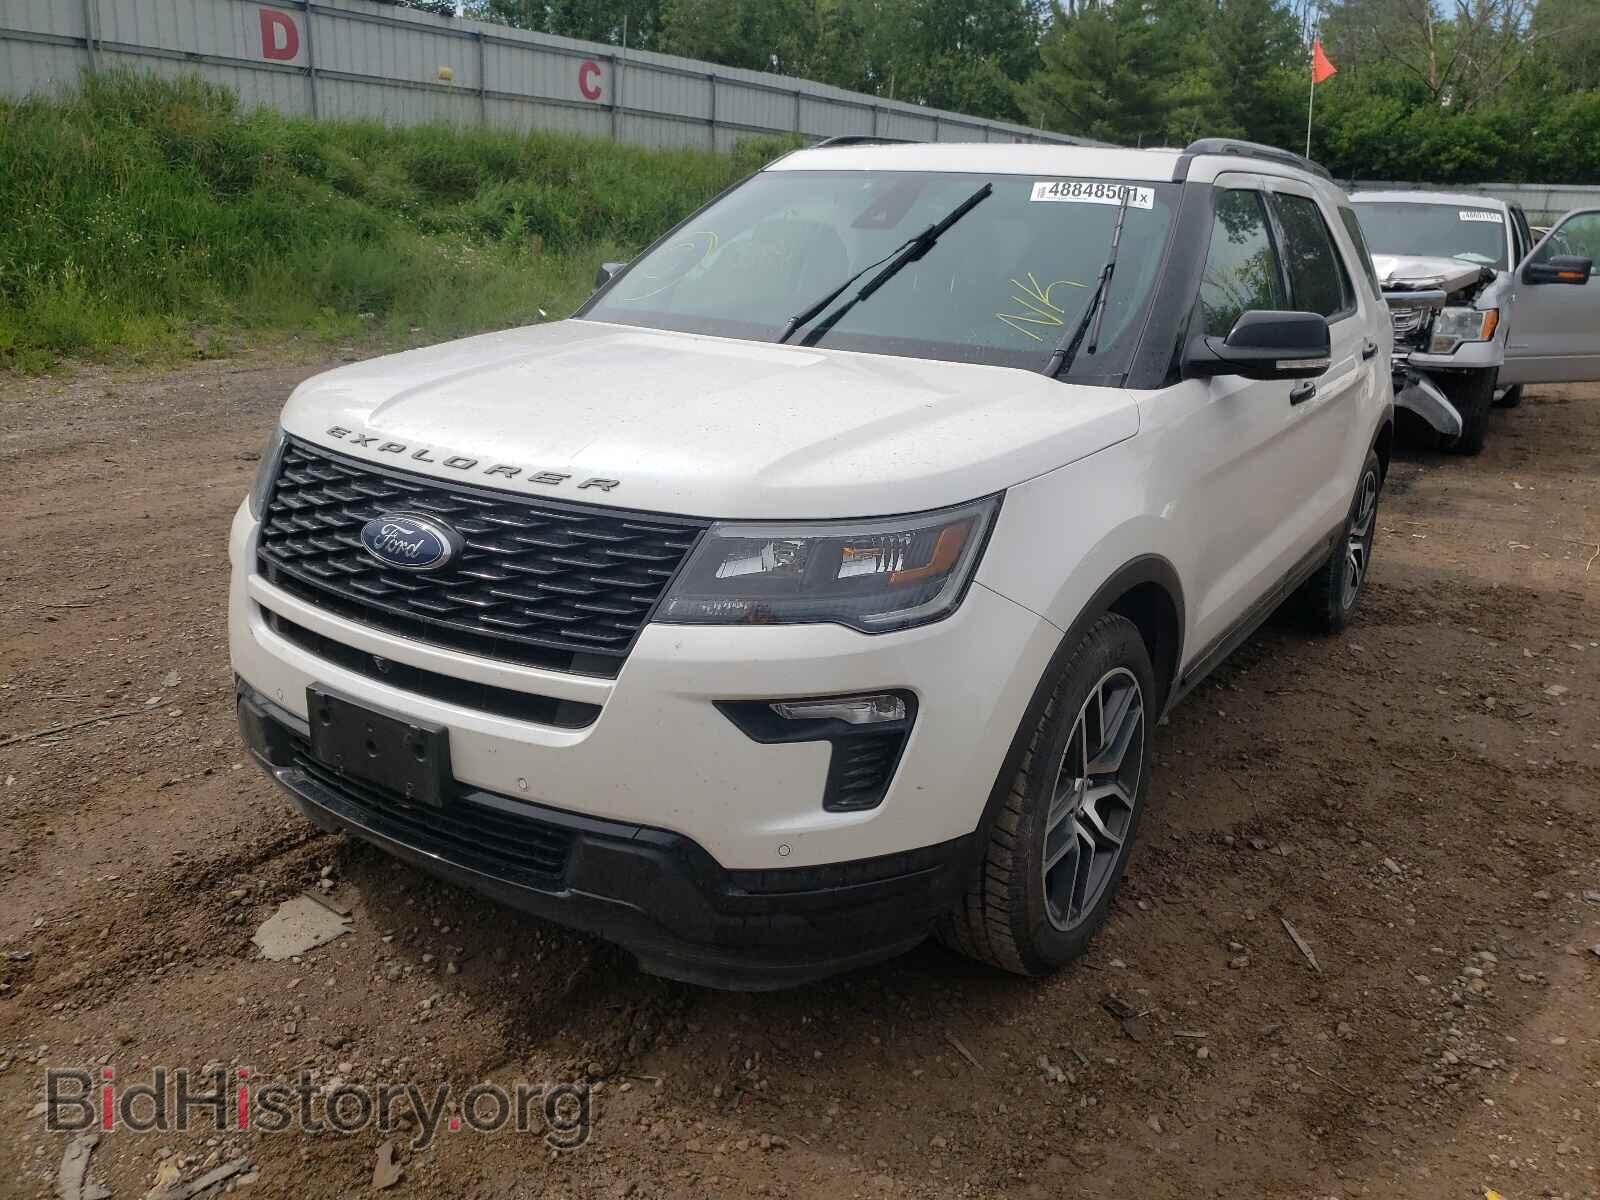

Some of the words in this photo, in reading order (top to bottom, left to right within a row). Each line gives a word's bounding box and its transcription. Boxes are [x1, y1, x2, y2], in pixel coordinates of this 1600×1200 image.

[259, 8, 299, 61] D
[578, 60, 602, 100] C
[326, 425, 621, 492] EXPLORER
[374, 523, 425, 559] Ford
